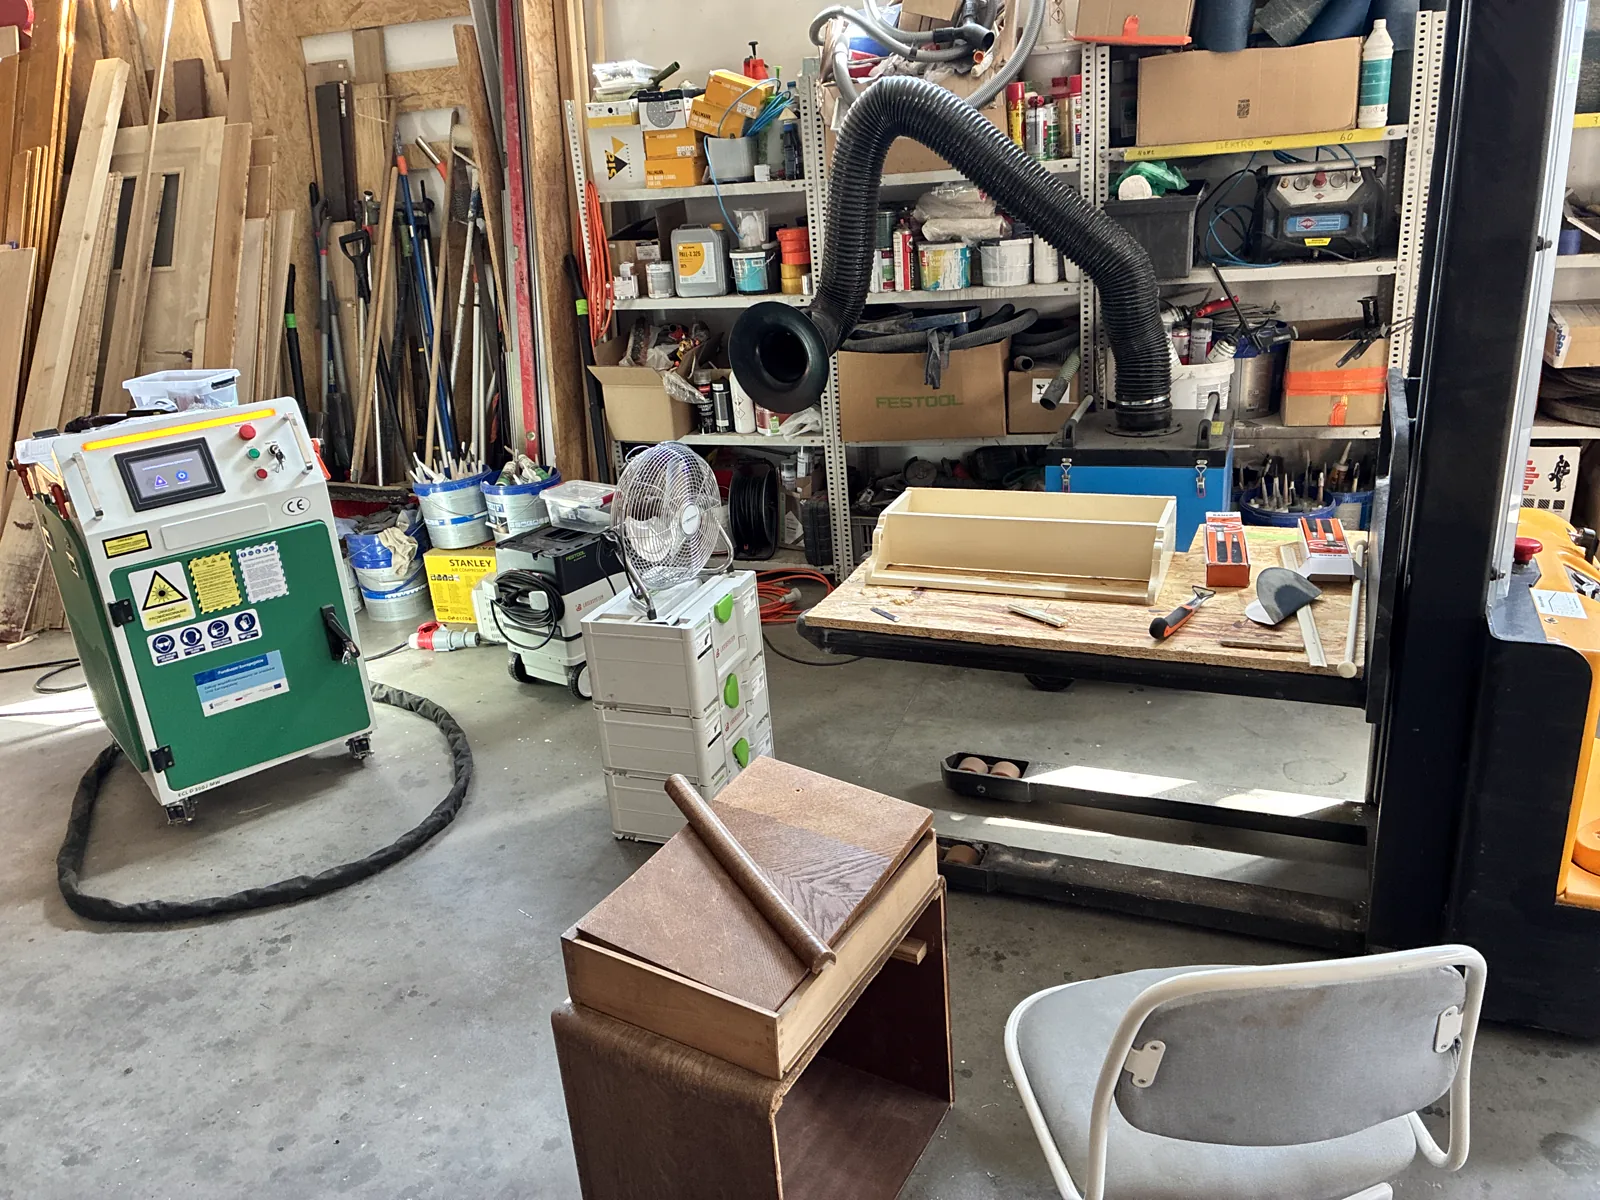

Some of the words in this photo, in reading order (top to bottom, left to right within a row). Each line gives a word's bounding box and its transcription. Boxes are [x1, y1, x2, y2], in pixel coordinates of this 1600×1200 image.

[1340, 132, 1354, 142] 60
[875, 394, 964, 409] FESTOOL
[449, 559, 492, 568] STANLEY
